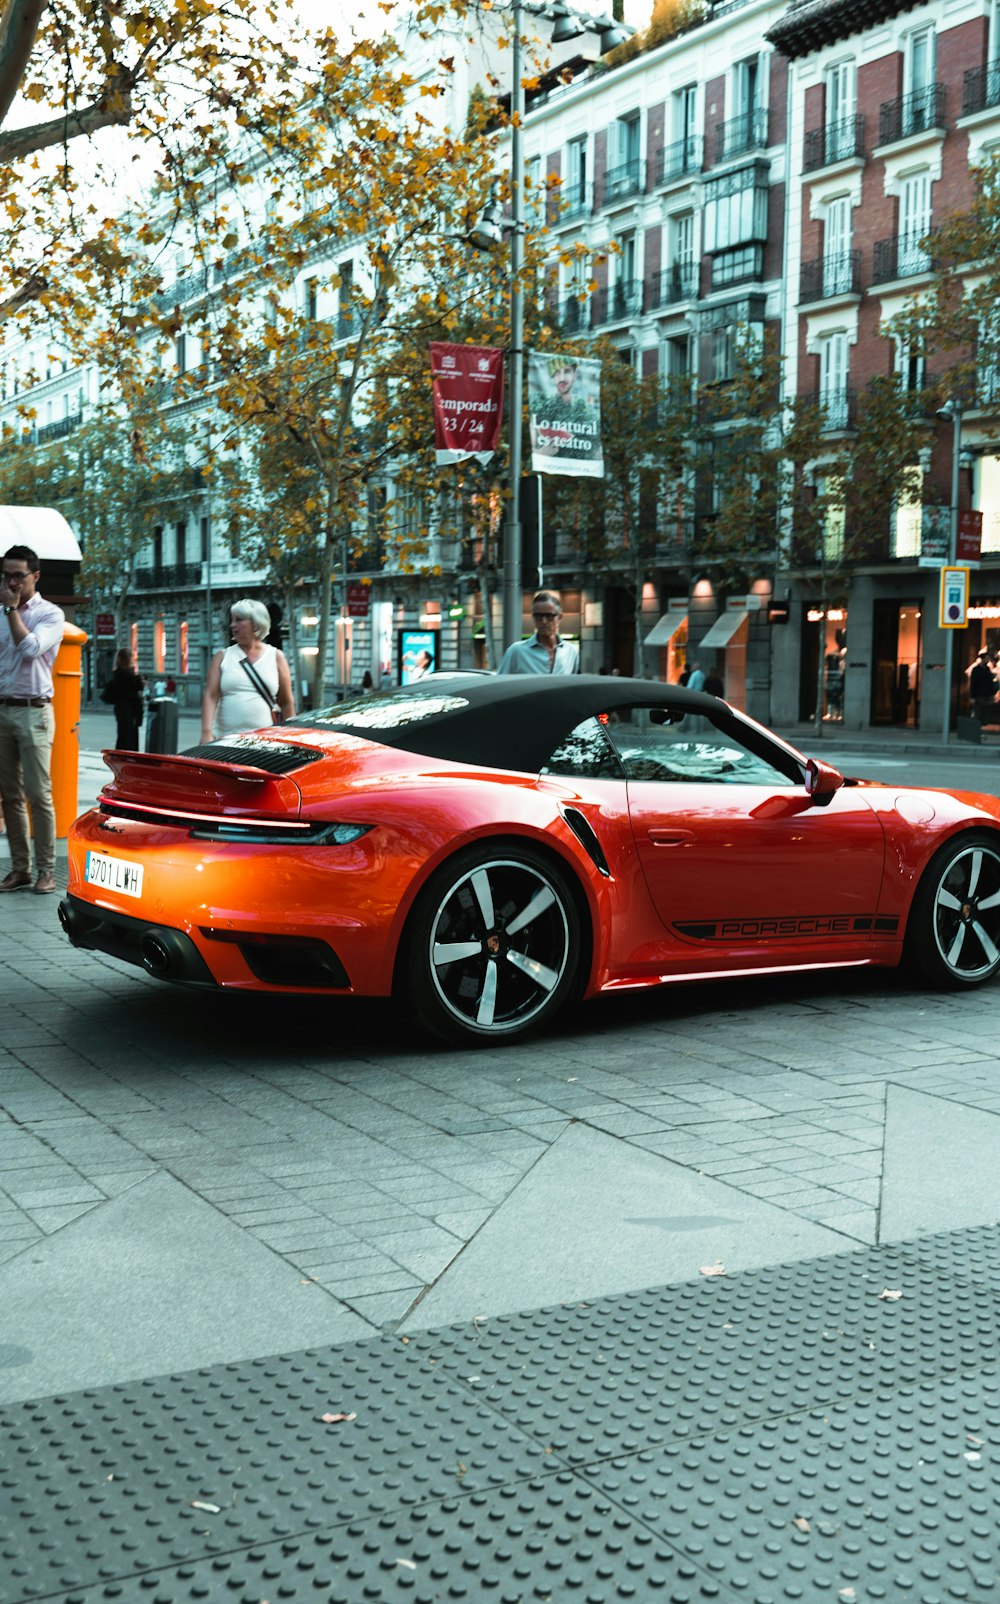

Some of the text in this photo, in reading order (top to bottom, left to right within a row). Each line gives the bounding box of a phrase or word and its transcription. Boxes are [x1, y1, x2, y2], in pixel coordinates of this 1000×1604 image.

[437, 394, 498, 415] emporada
[443, 416, 458, 431] 23
[469, 419, 485, 433] 24
[531, 413, 598, 436] Lo natural
[537, 434, 592, 451] es teatro
[90, 857, 139, 892] 3701 LWH
[722, 919, 849, 936] PORSCHE
